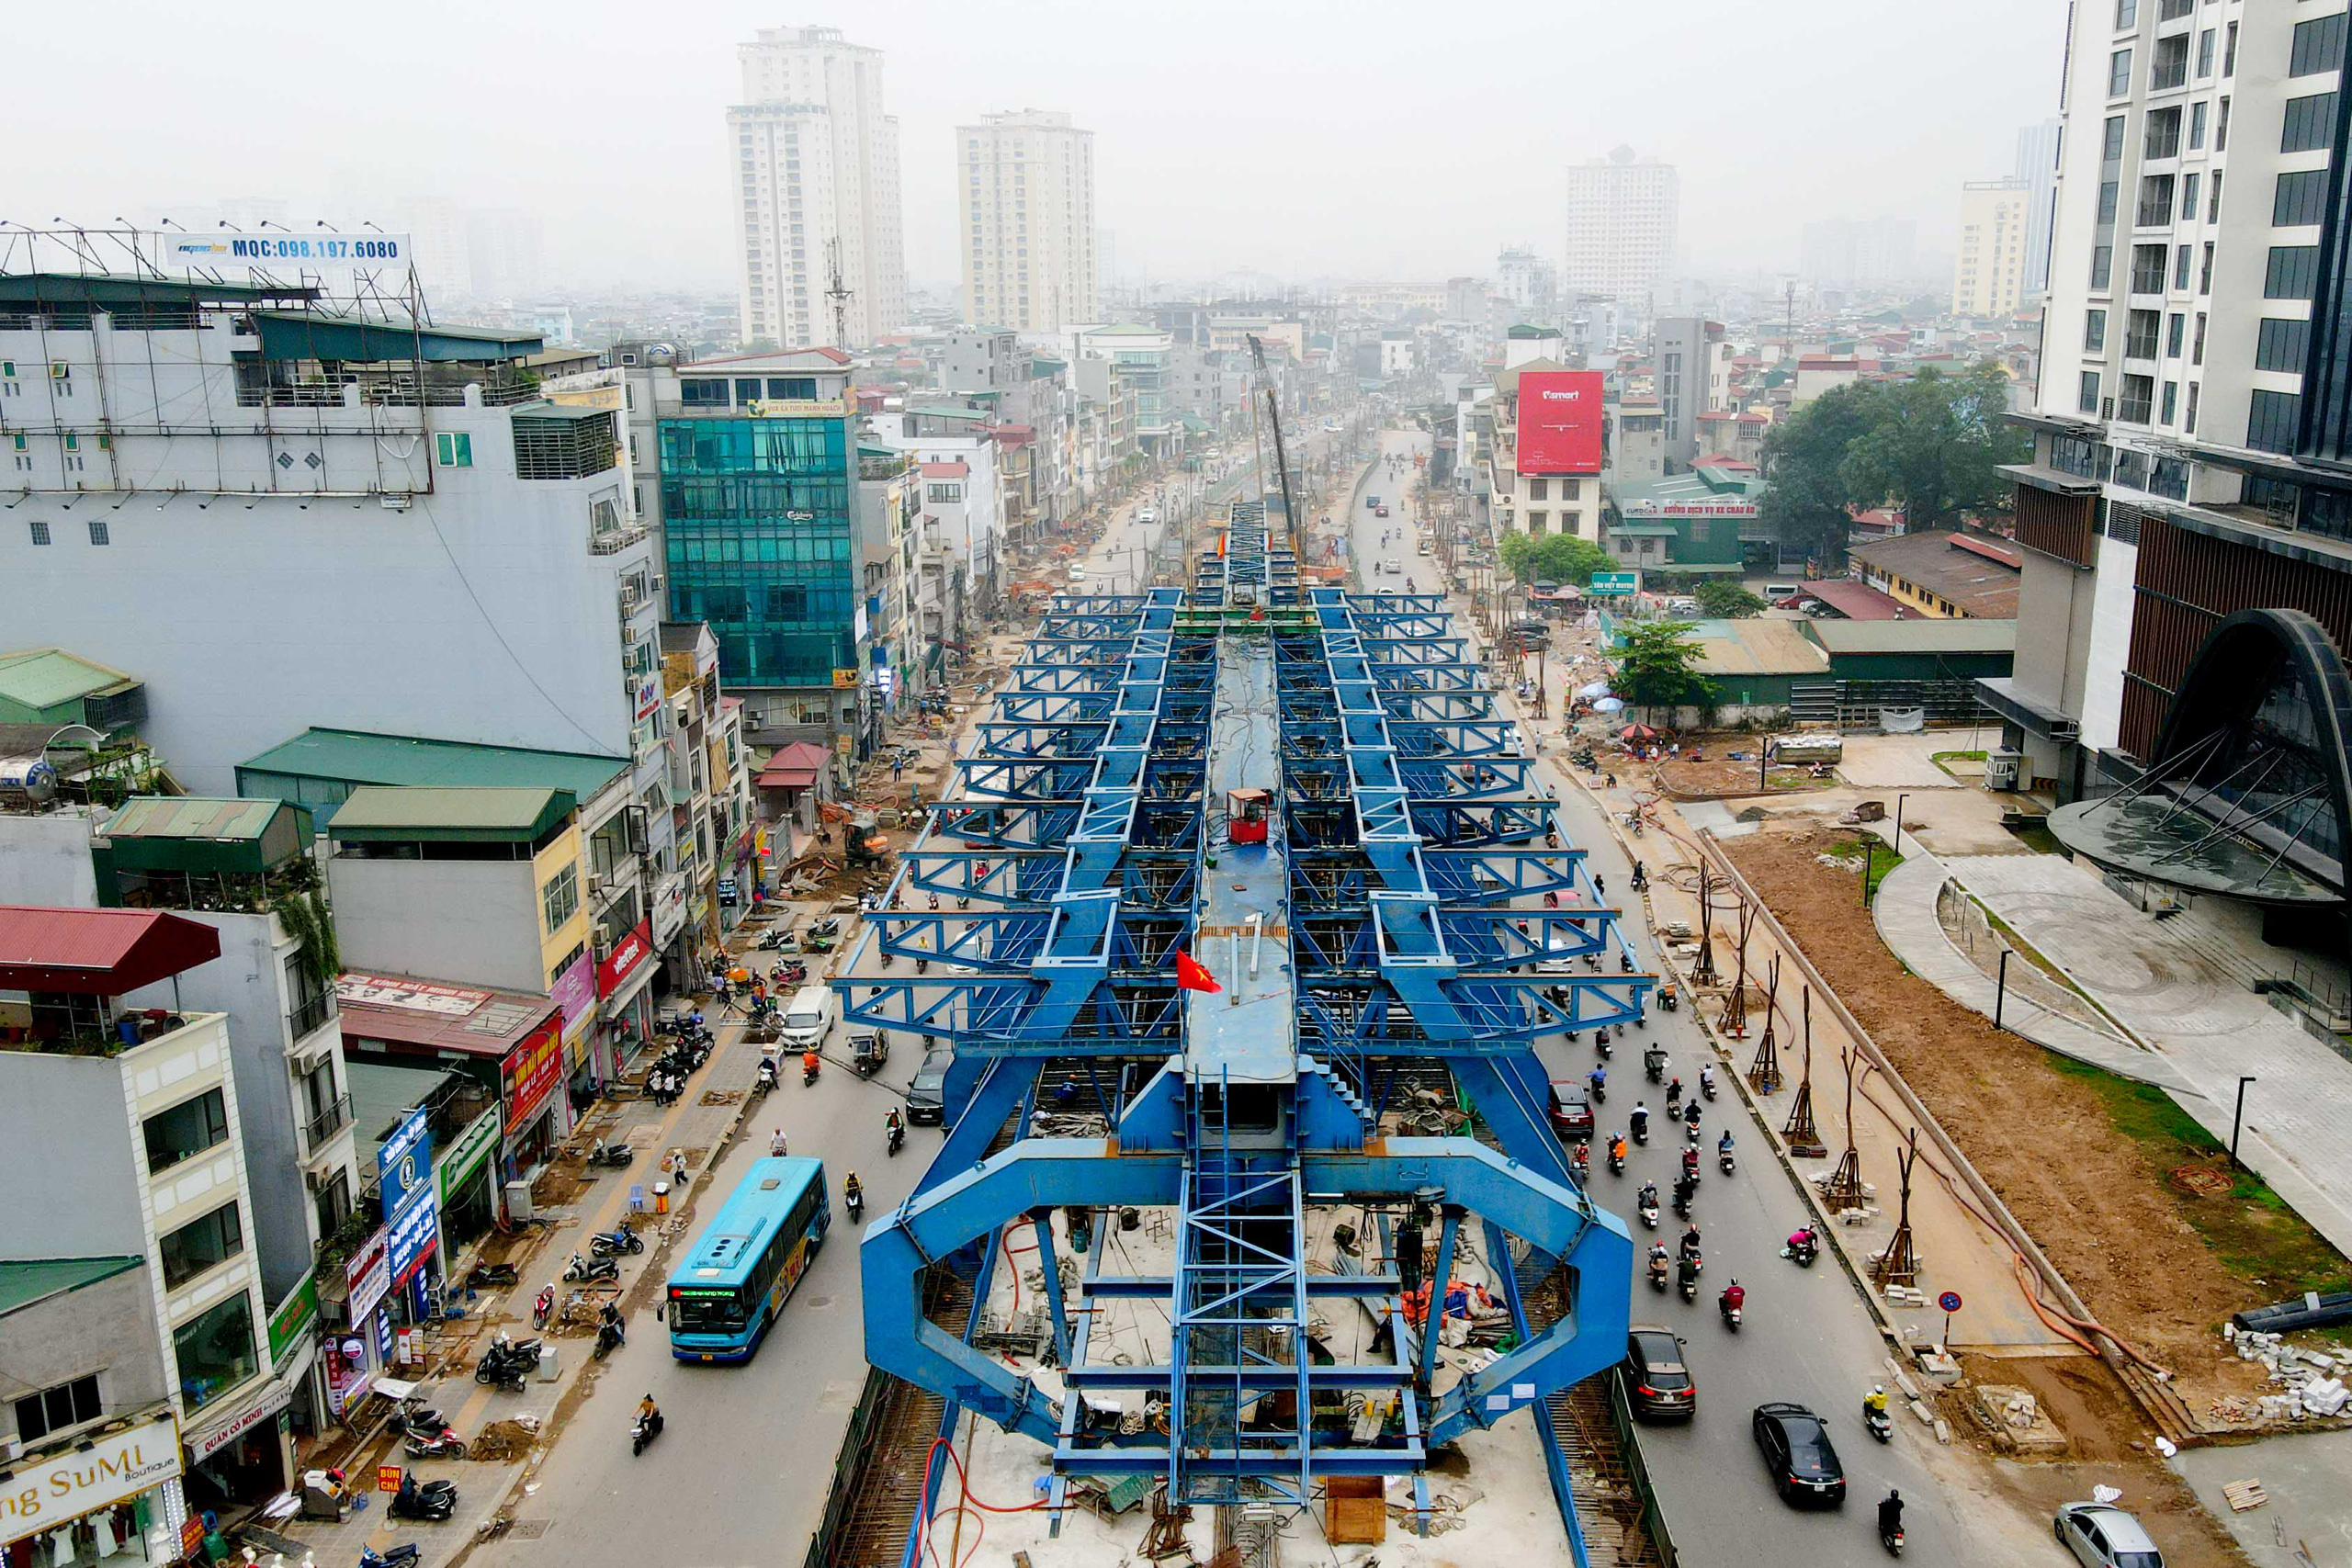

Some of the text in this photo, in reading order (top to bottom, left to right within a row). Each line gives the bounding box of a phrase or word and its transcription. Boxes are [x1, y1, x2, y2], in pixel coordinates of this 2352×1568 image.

[232, 239, 398, 258] MQC:098.197.6080
[613, 939, 639, 976] viettel
[242, 1407, 263, 1427] MINH
[124, 1458, 175, 1483] Boutique
[379, 1468, 401, 1479] BÚN
[380, 1480, 401, 1492] CHẢ
